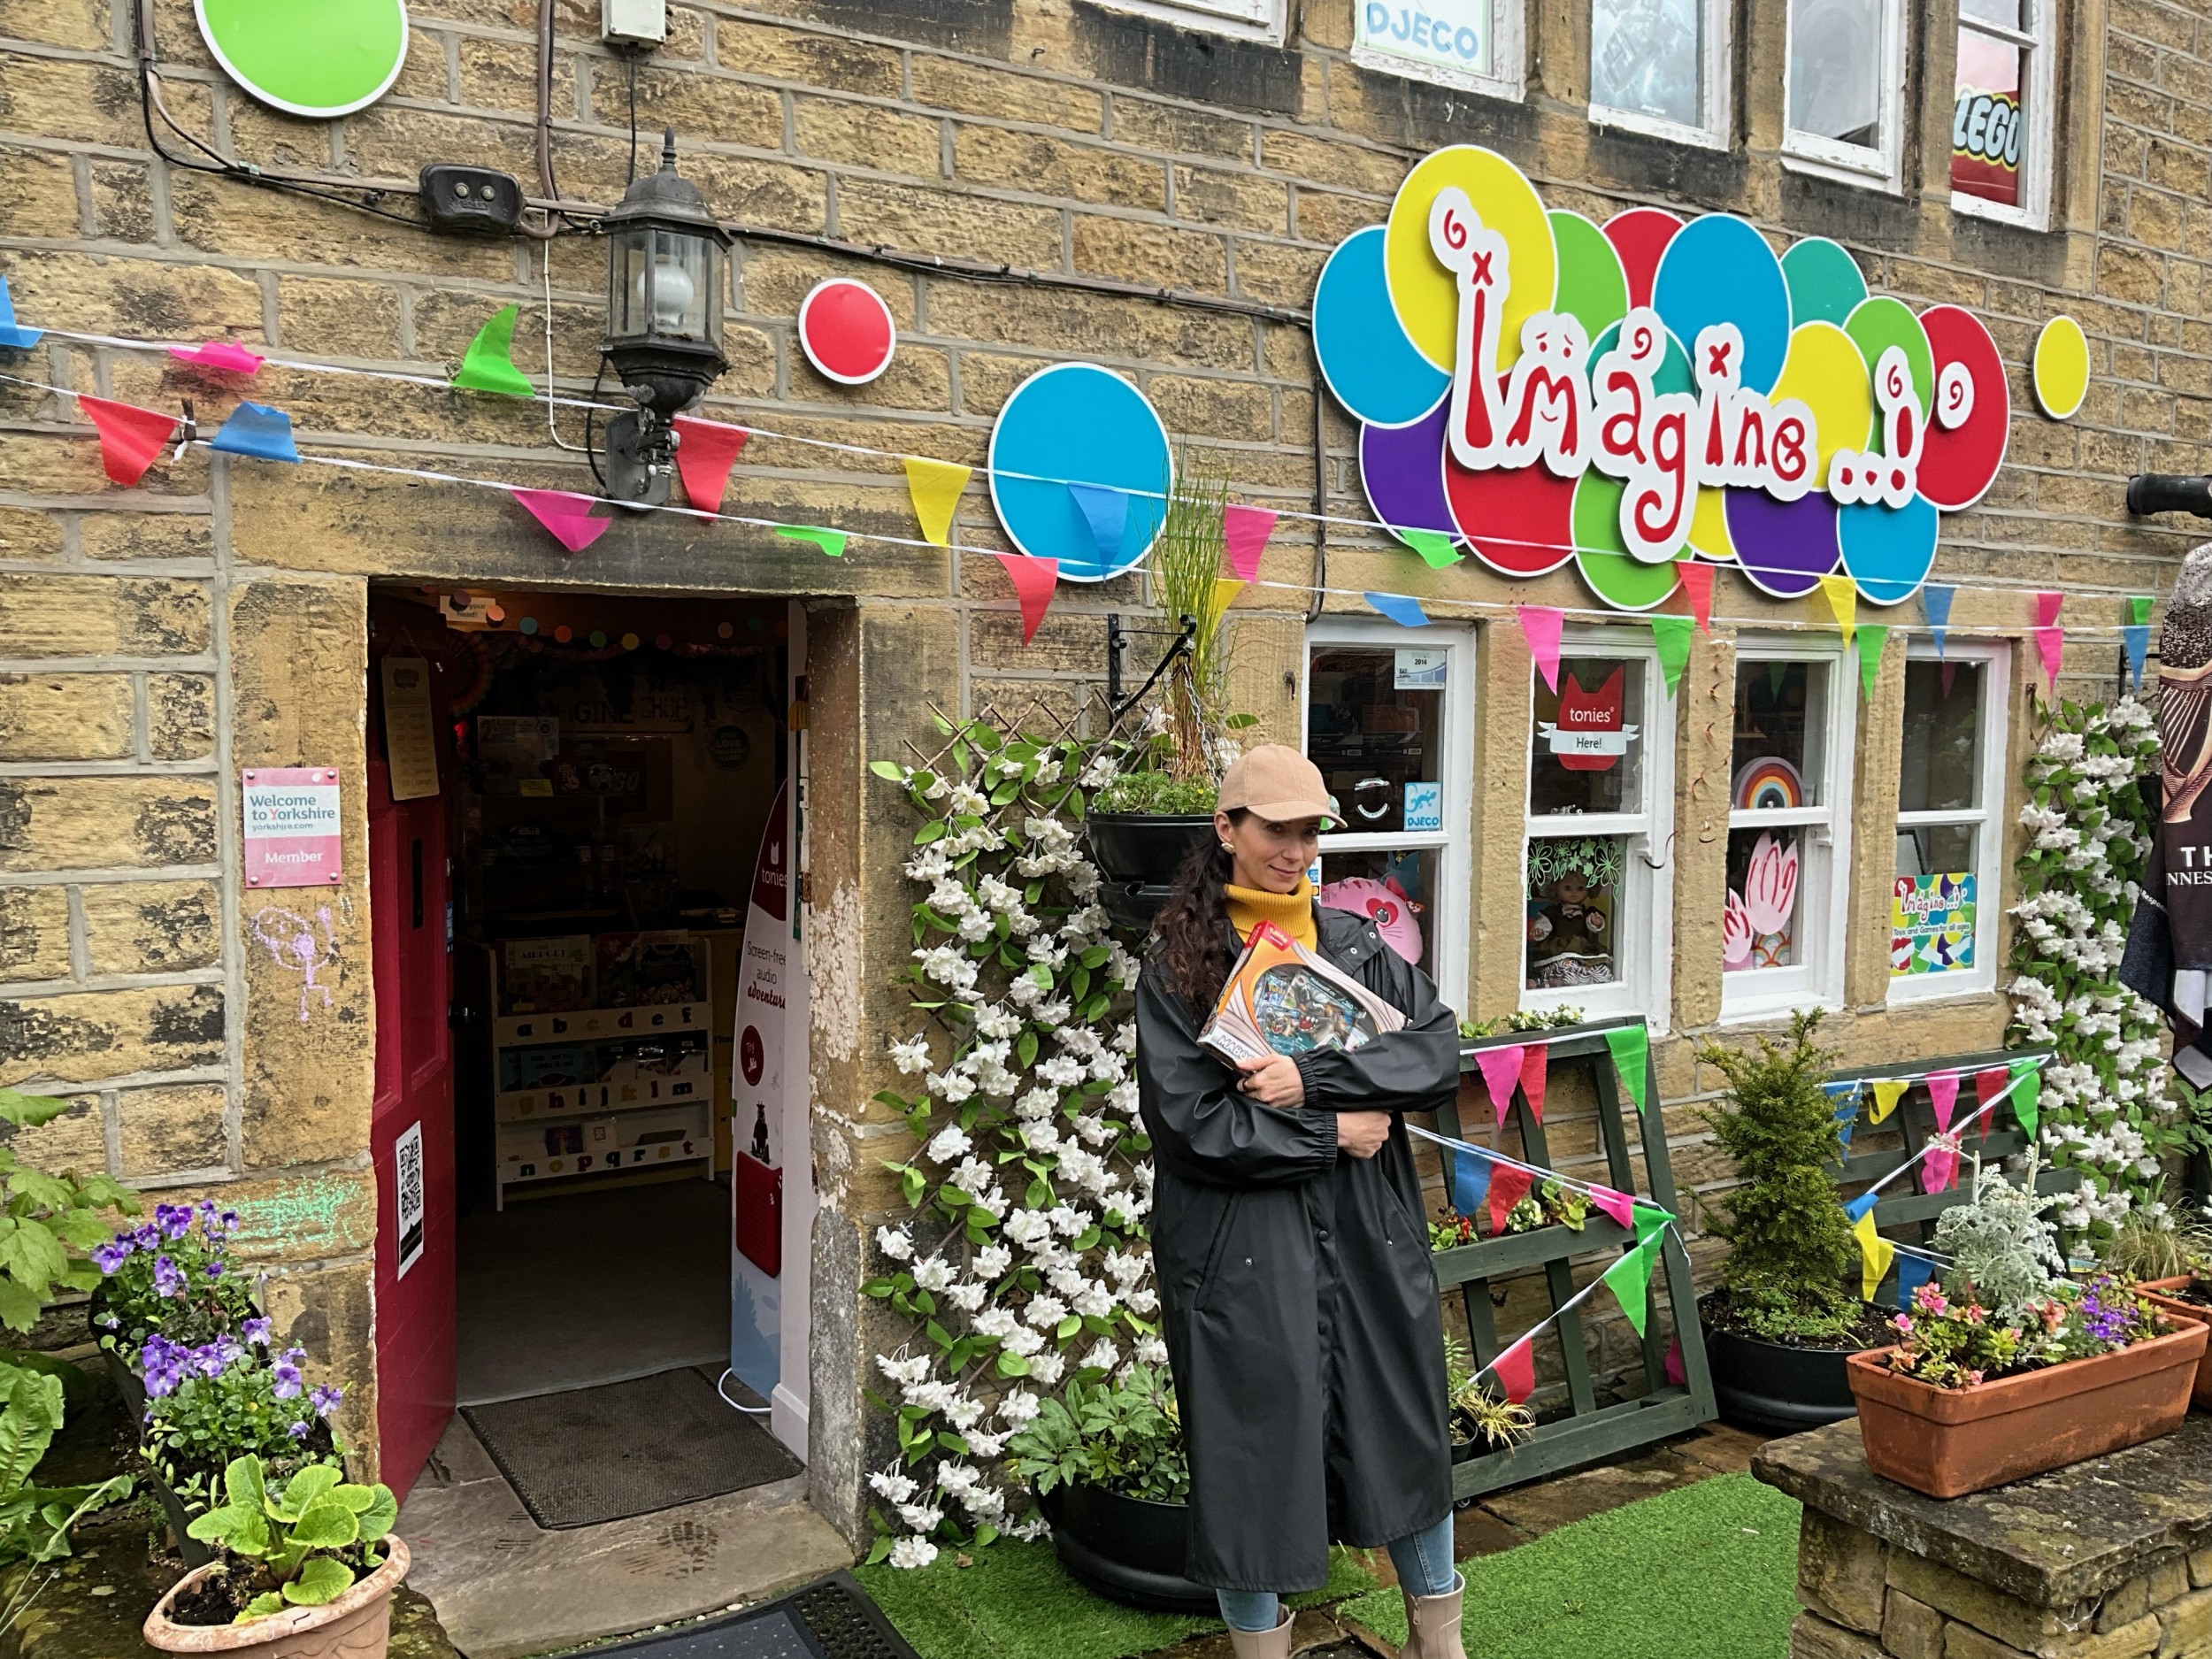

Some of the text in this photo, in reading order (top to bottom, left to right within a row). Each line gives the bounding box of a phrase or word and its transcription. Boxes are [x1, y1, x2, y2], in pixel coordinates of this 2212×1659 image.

[1366, 2, 1479, 60] DJECO
[1954, 92, 2020, 164] LEGO
[1576, 737, 1602, 749] Here!
[250, 795, 317, 807] Welcome
[251, 807, 335, 821] to Yorkshire
[252, 822, 313, 832] yorkshire.com
[1407, 817, 1439, 826] DJECO
[265, 850, 323, 864] Member
[1957, 923, 1970, 932] ages
[757, 968, 778, 985] audio
[517, 1024, 533, 1037] a
[553, 1018, 567, 1033] b
[618, 1011, 633, 1028] d
[651, 1013, 664, 1026] e
[681, 1006, 692, 1023] f
[549, 1092, 565, 1108] h
[621, 1084, 638, 1102] k
[672, 1082, 693, 1096] m
[520, 1164, 535, 1177] n
[578, 1155, 592, 1172] p
[606, 1151, 620, 1168] q
[634, 1148, 646, 1162] r
[682, 1140, 694, 1155] t
